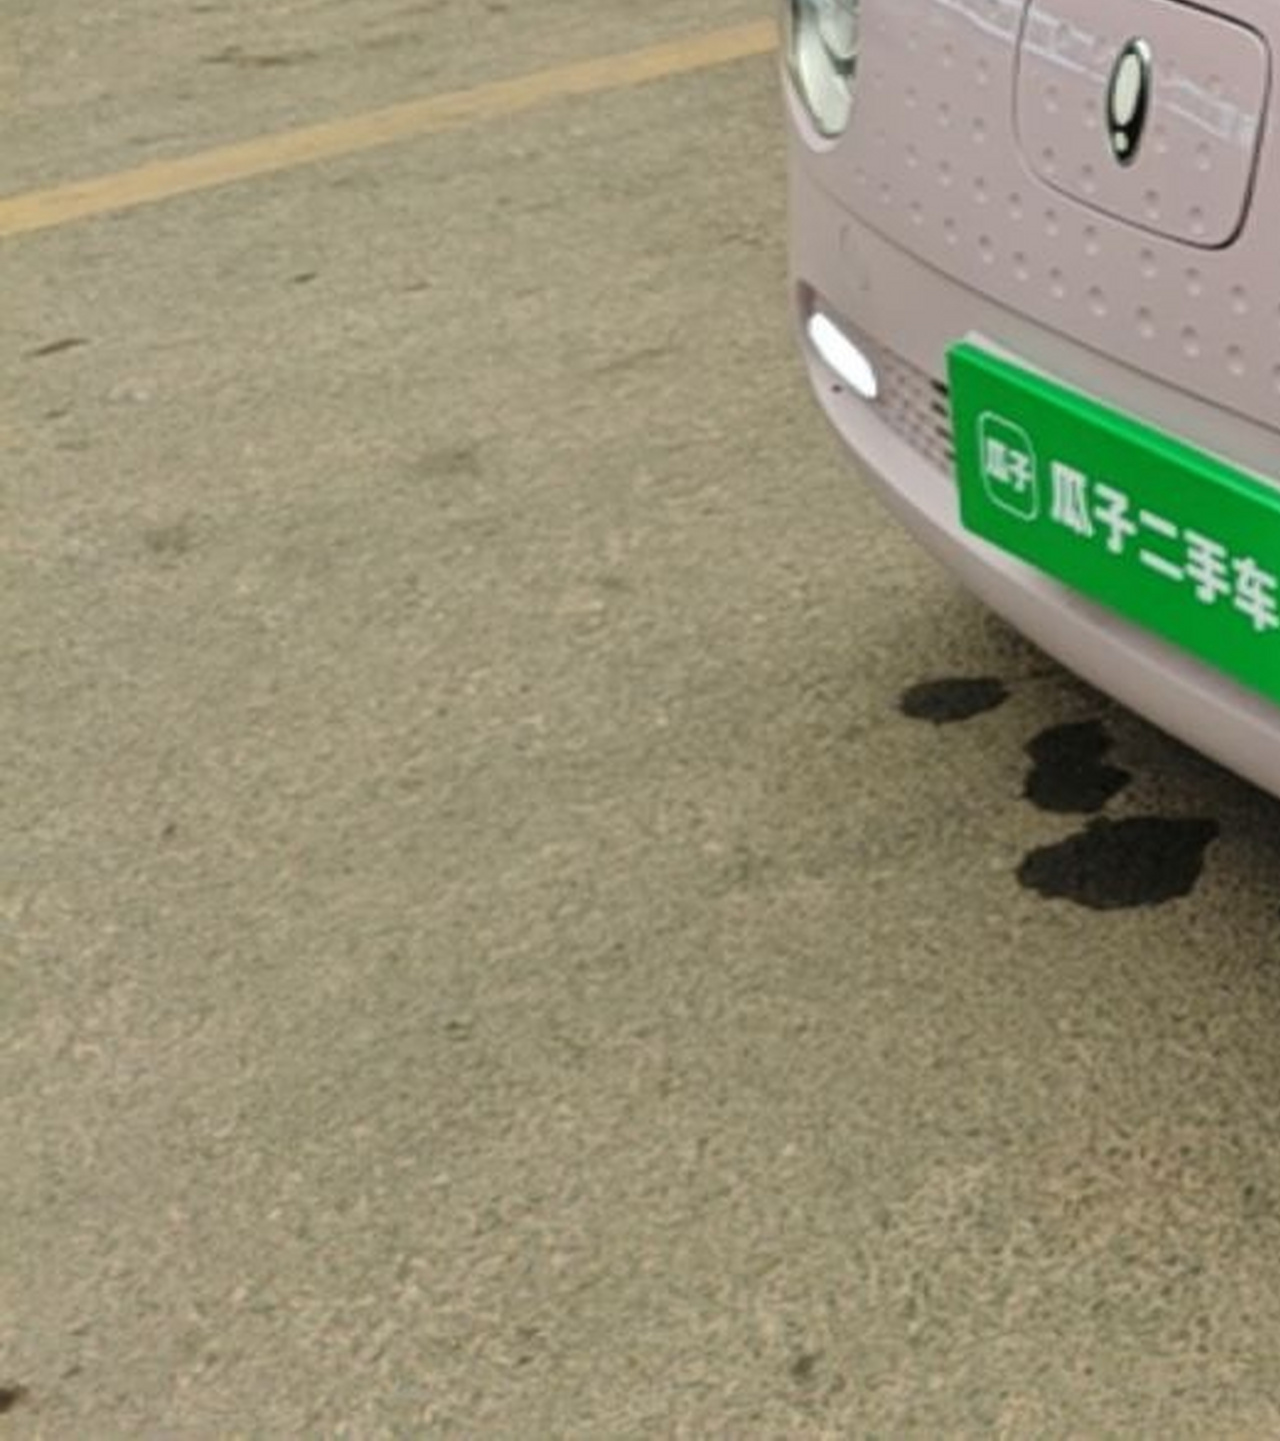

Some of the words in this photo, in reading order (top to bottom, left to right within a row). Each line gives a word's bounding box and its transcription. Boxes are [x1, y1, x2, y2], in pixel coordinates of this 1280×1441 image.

[1049, 460, 1280, 632] 瓜子二手车
